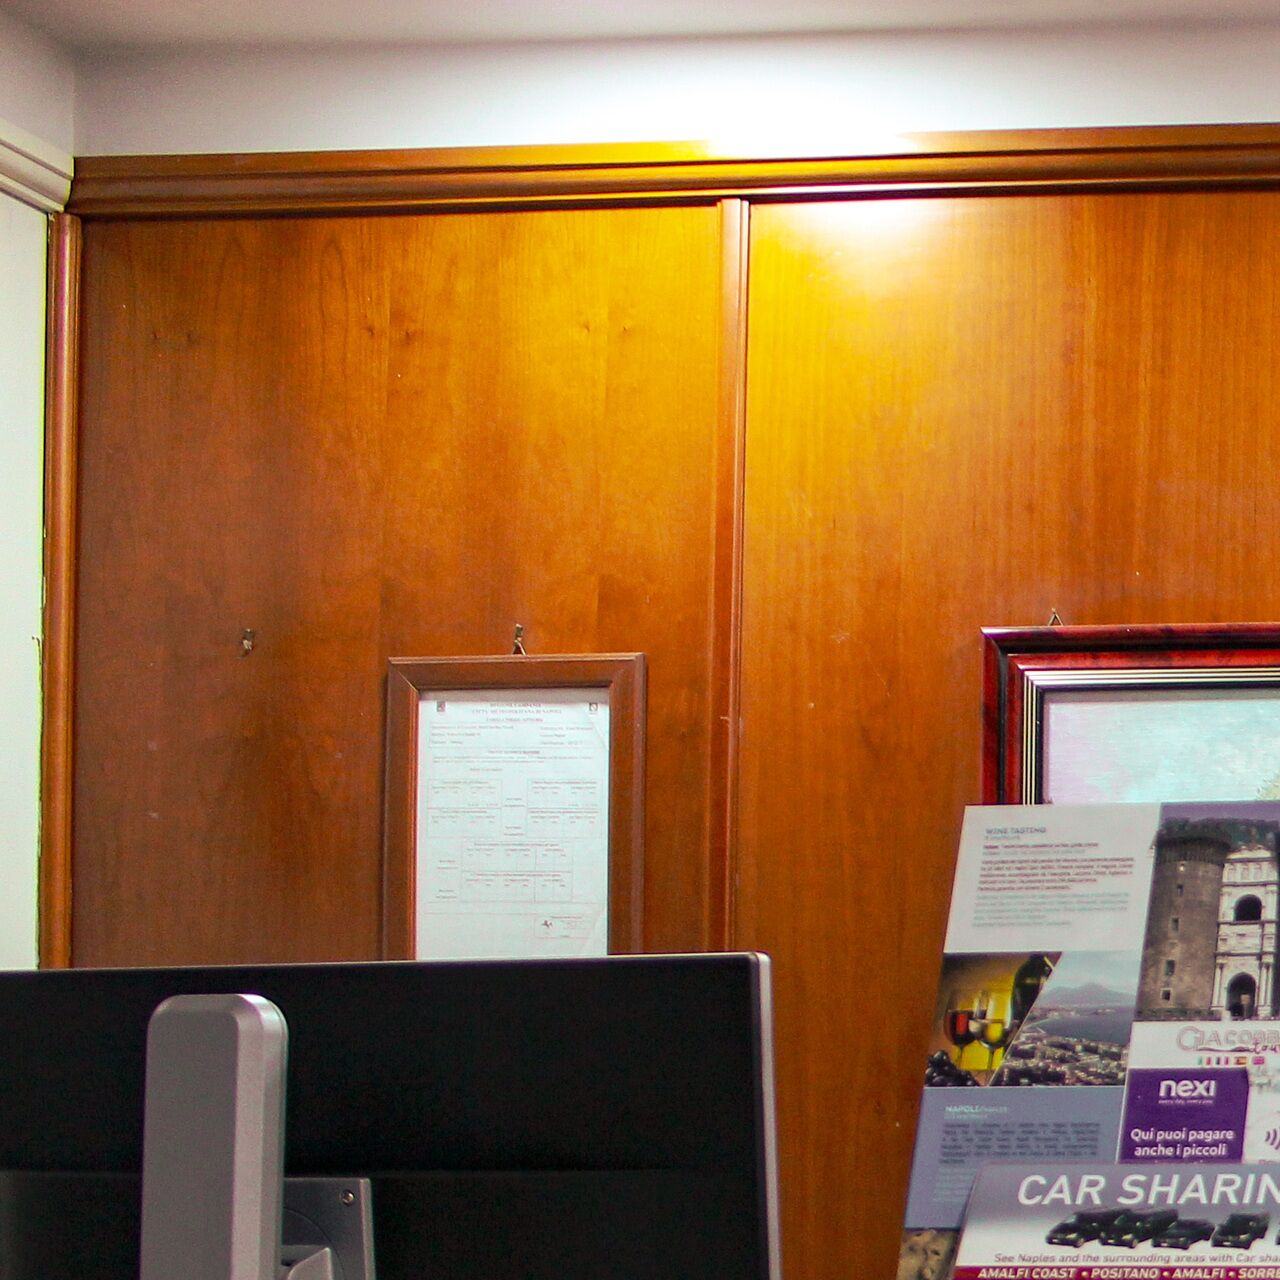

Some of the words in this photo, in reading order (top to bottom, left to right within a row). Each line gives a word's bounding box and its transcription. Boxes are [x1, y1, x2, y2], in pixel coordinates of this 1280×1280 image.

[1159, 1079, 1215, 1097] nexi
[1131, 1129, 1154, 1140] Qui
[1156, 1128, 1186, 1142] puoi
[1188, 1130, 1234, 1143] pagare
[1134, 1144, 1173, 1156] anche
[1176, 1144, 1181, 1155] i
[1183, 1144, 1225, 1158] piccoli
[1018, 1174, 1106, 1205] CAR
[994, 1254, 1014, 1263] See
[1018, 1254, 1055, 1265] Naples
[1059, 1254, 1079, 1263] and
[1083, 1254, 1098, 1263] the
[1103, 1254, 1169, 1265] surrounding
[1209, 1254, 1232, 1263] with
[1236, 1254, 1255, 1263] Car
[978, 1267, 1029, 1279] AMALFI
[1031, 1267, 1076, 1279] COAST
[1091, 1267, 1158, 1279] POSITANO
[1172, 1267, 1226, 1279] AMALFI
